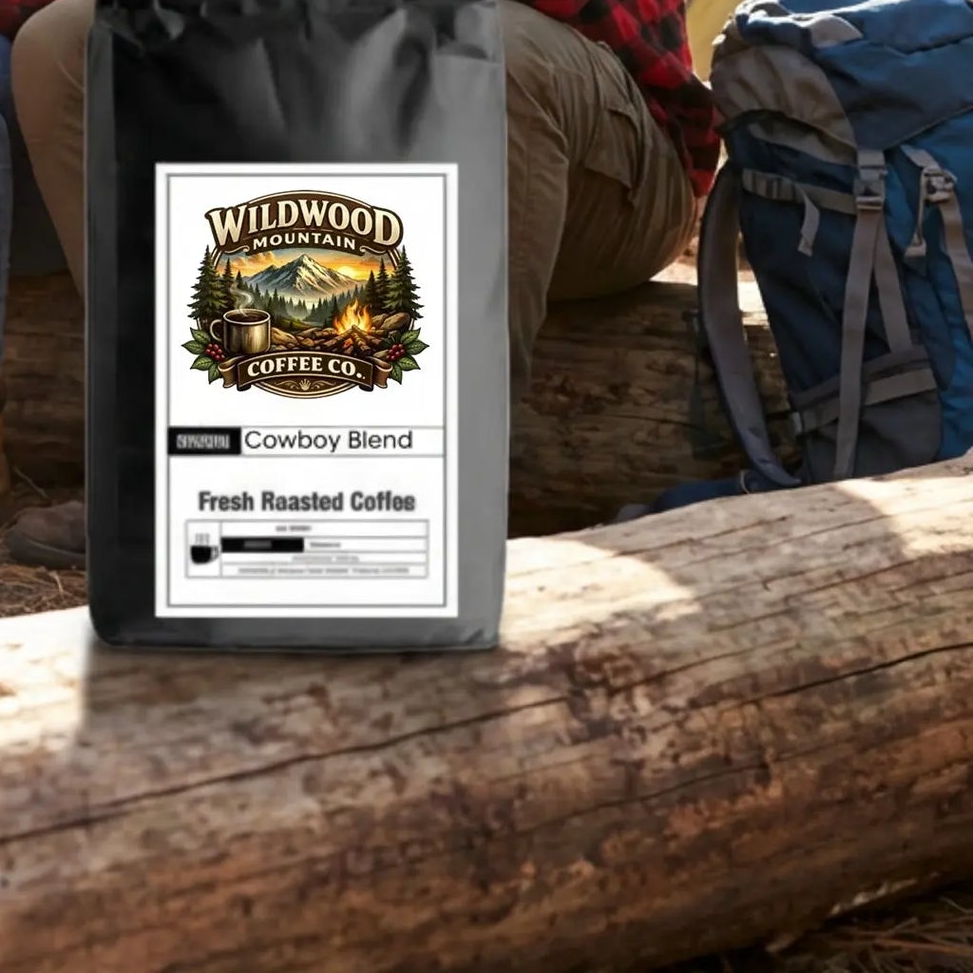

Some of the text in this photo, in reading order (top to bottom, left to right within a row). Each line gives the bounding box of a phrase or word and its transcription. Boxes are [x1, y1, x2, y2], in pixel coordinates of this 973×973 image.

[208, 198, 402, 247] WILDWOOD
[252, 232, 356, 251] MOUNTAIN
[247, 356, 323, 377] COFFEE
[244, 430, 342, 453] Cowboy
[348, 430, 413, 449] Blend
[198, 491, 254, 511] Fresh
